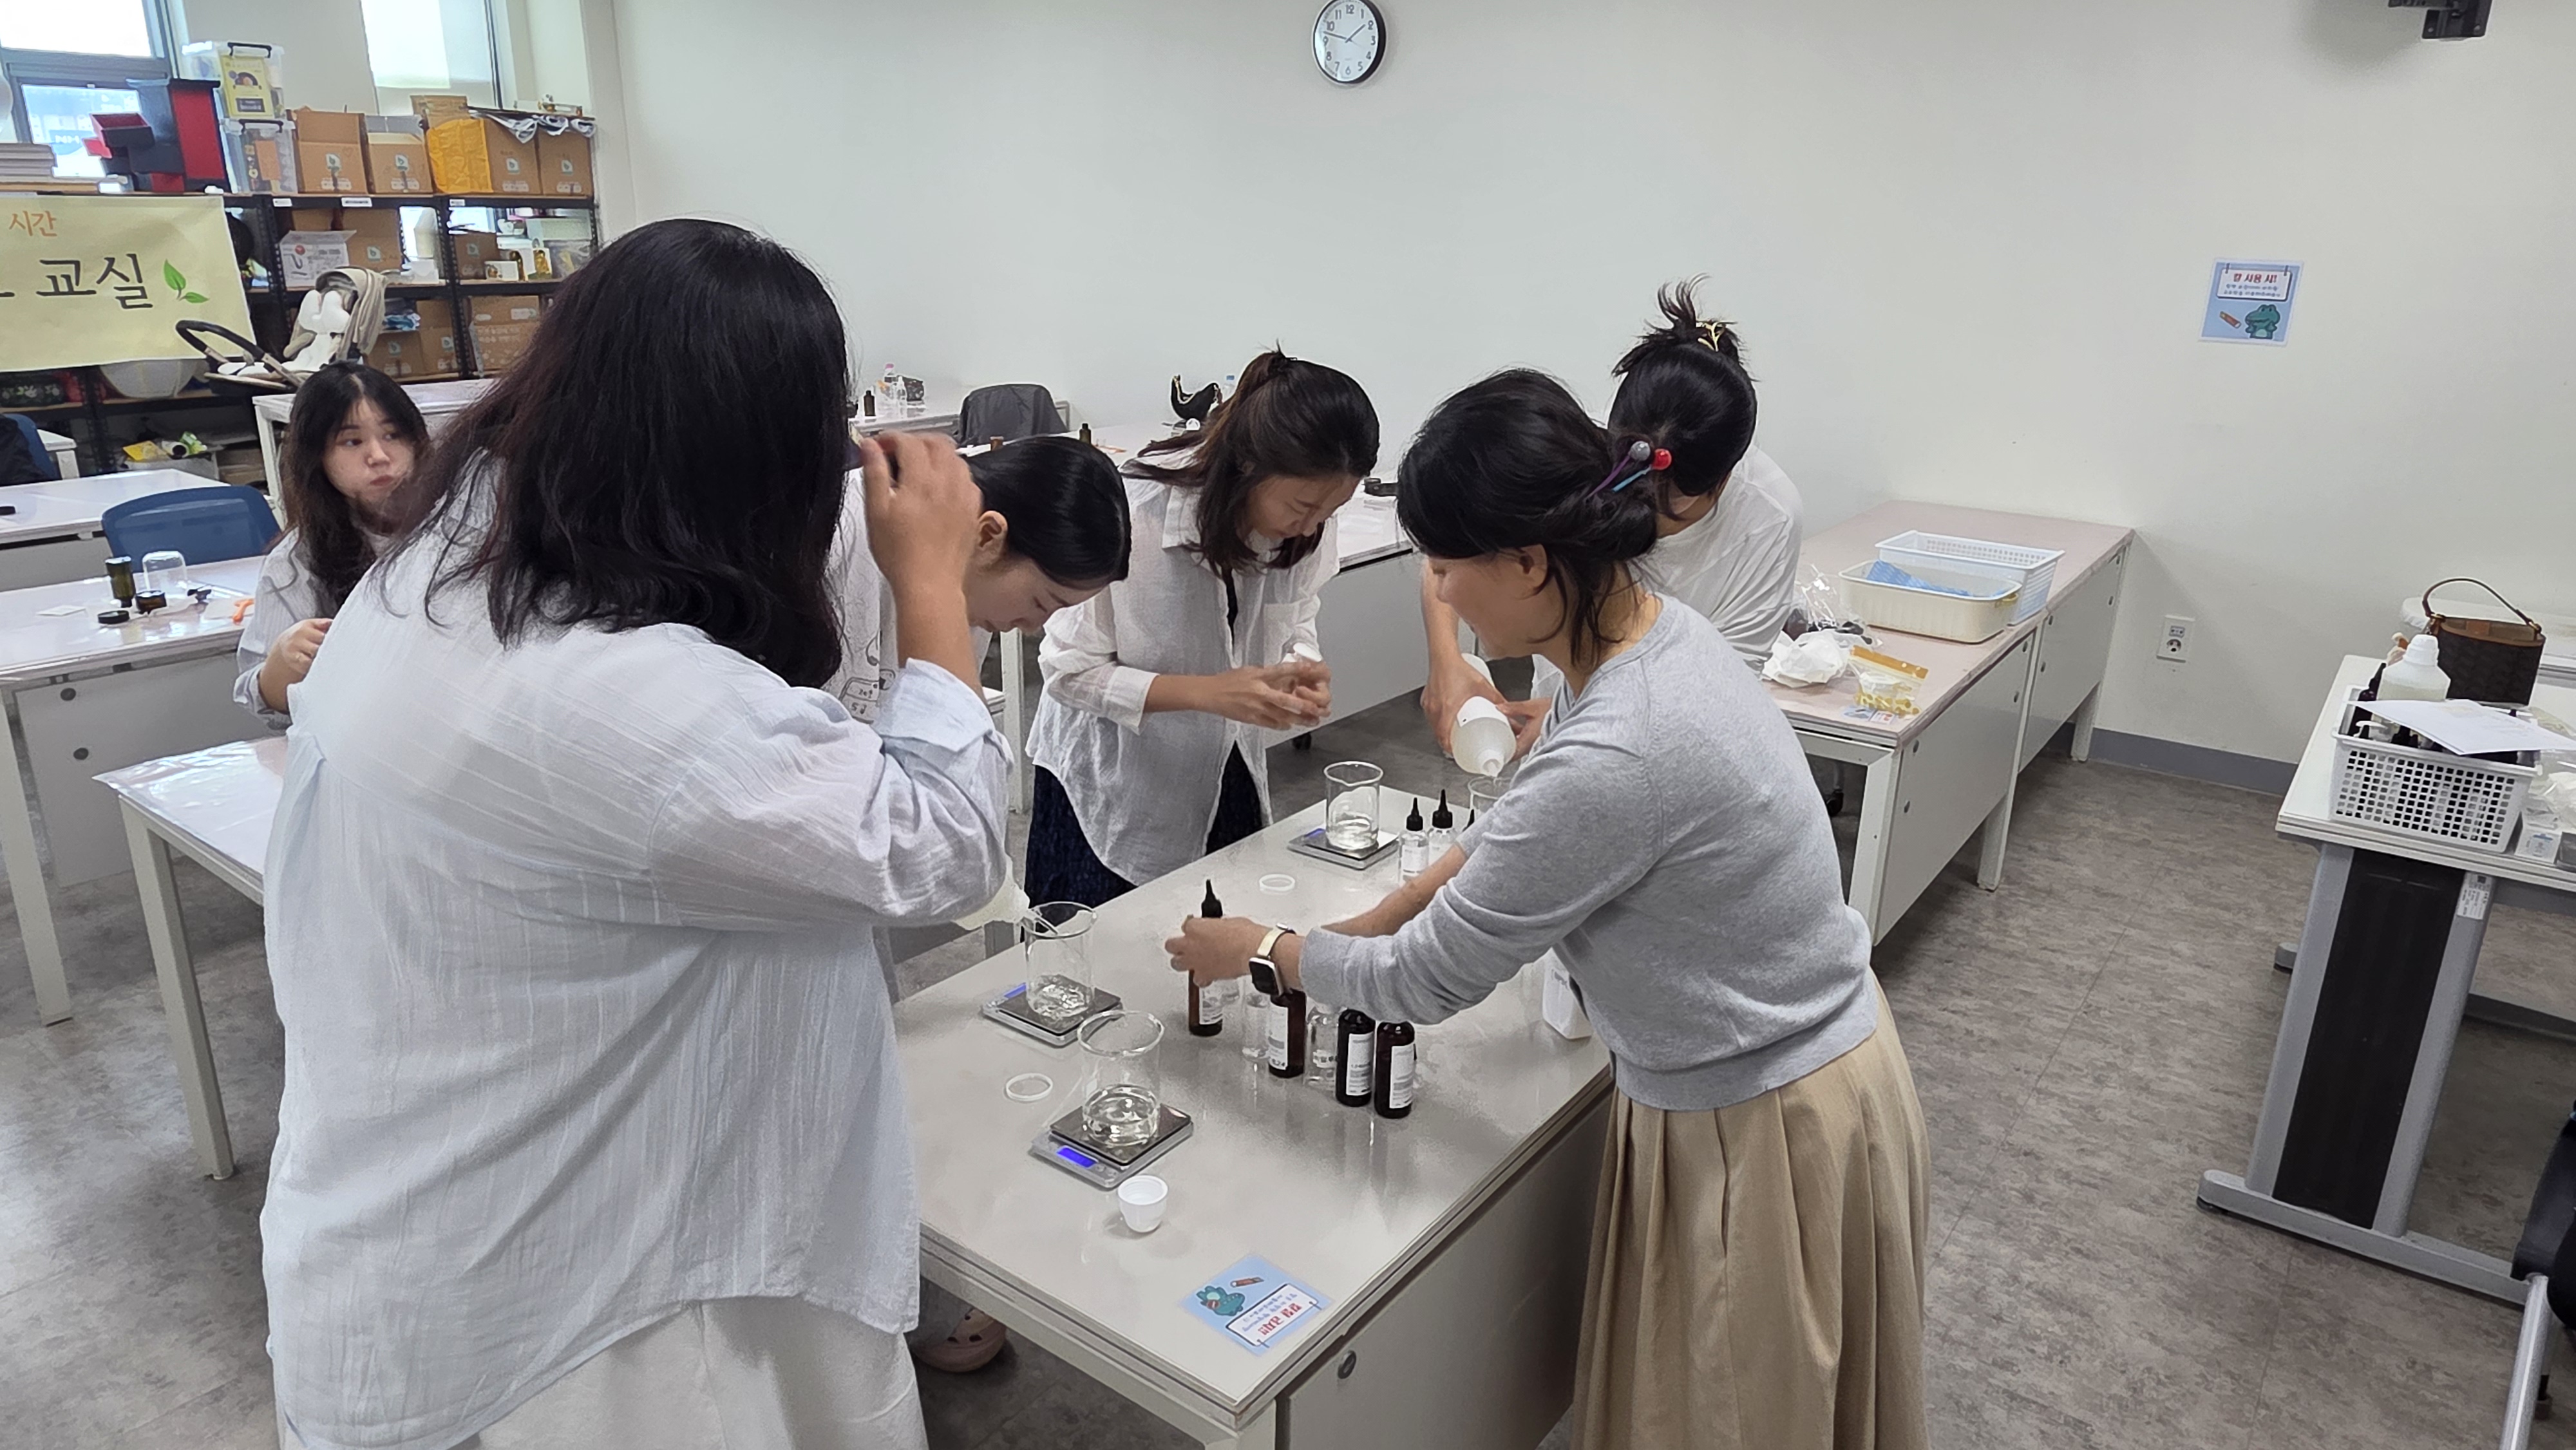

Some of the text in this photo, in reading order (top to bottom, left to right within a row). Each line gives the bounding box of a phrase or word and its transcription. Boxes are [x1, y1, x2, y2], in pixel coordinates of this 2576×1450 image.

[1346, 5, 1354, 14] 12
[1361, 8, 1364, 19] 1
[1335, 10, 1341, 19] 11
[1327, 21, 1334, 31] 10
[1368, 21, 1373, 30] 2
[1323, 35, 1329, 46] 9
[1371, 35, 1376, 45] 3
[1326, 52, 1332, 61] 8
[1334, 62, 1340, 71] 7
[1345, 66, 1350, 75] 6
[1358, 62, 1363, 71] 5
[9, 210, 58, 238] 시간
[36, 253, 154, 310] 교실
